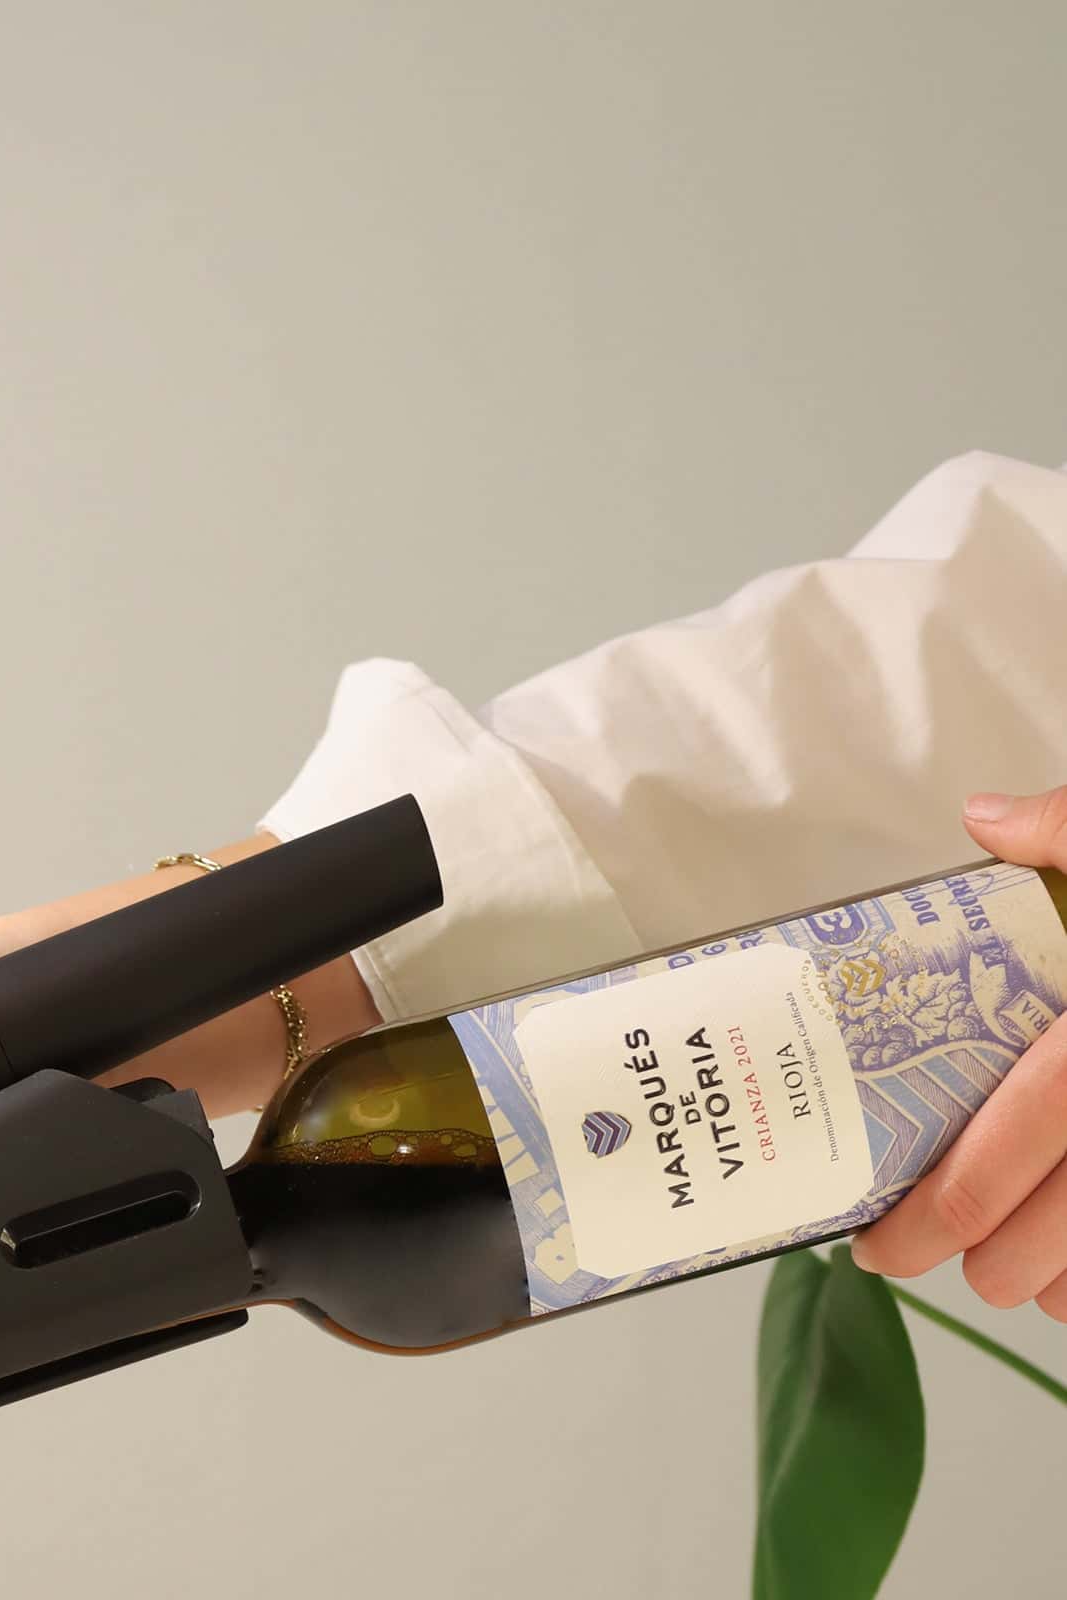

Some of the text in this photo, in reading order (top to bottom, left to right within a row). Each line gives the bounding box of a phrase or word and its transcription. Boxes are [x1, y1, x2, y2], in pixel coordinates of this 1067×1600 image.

[623, 1028, 695, 1209] MARQUÉS
[679, 1090, 702, 1125] DE
[685, 1026, 744, 1180] VITORIA
[727, 1026, 776, 1162] CRIANZA 2021
[776, 1042, 811, 1119] RIOJA
[786, 991, 839, 1162] Denominación de Origen Calificada
